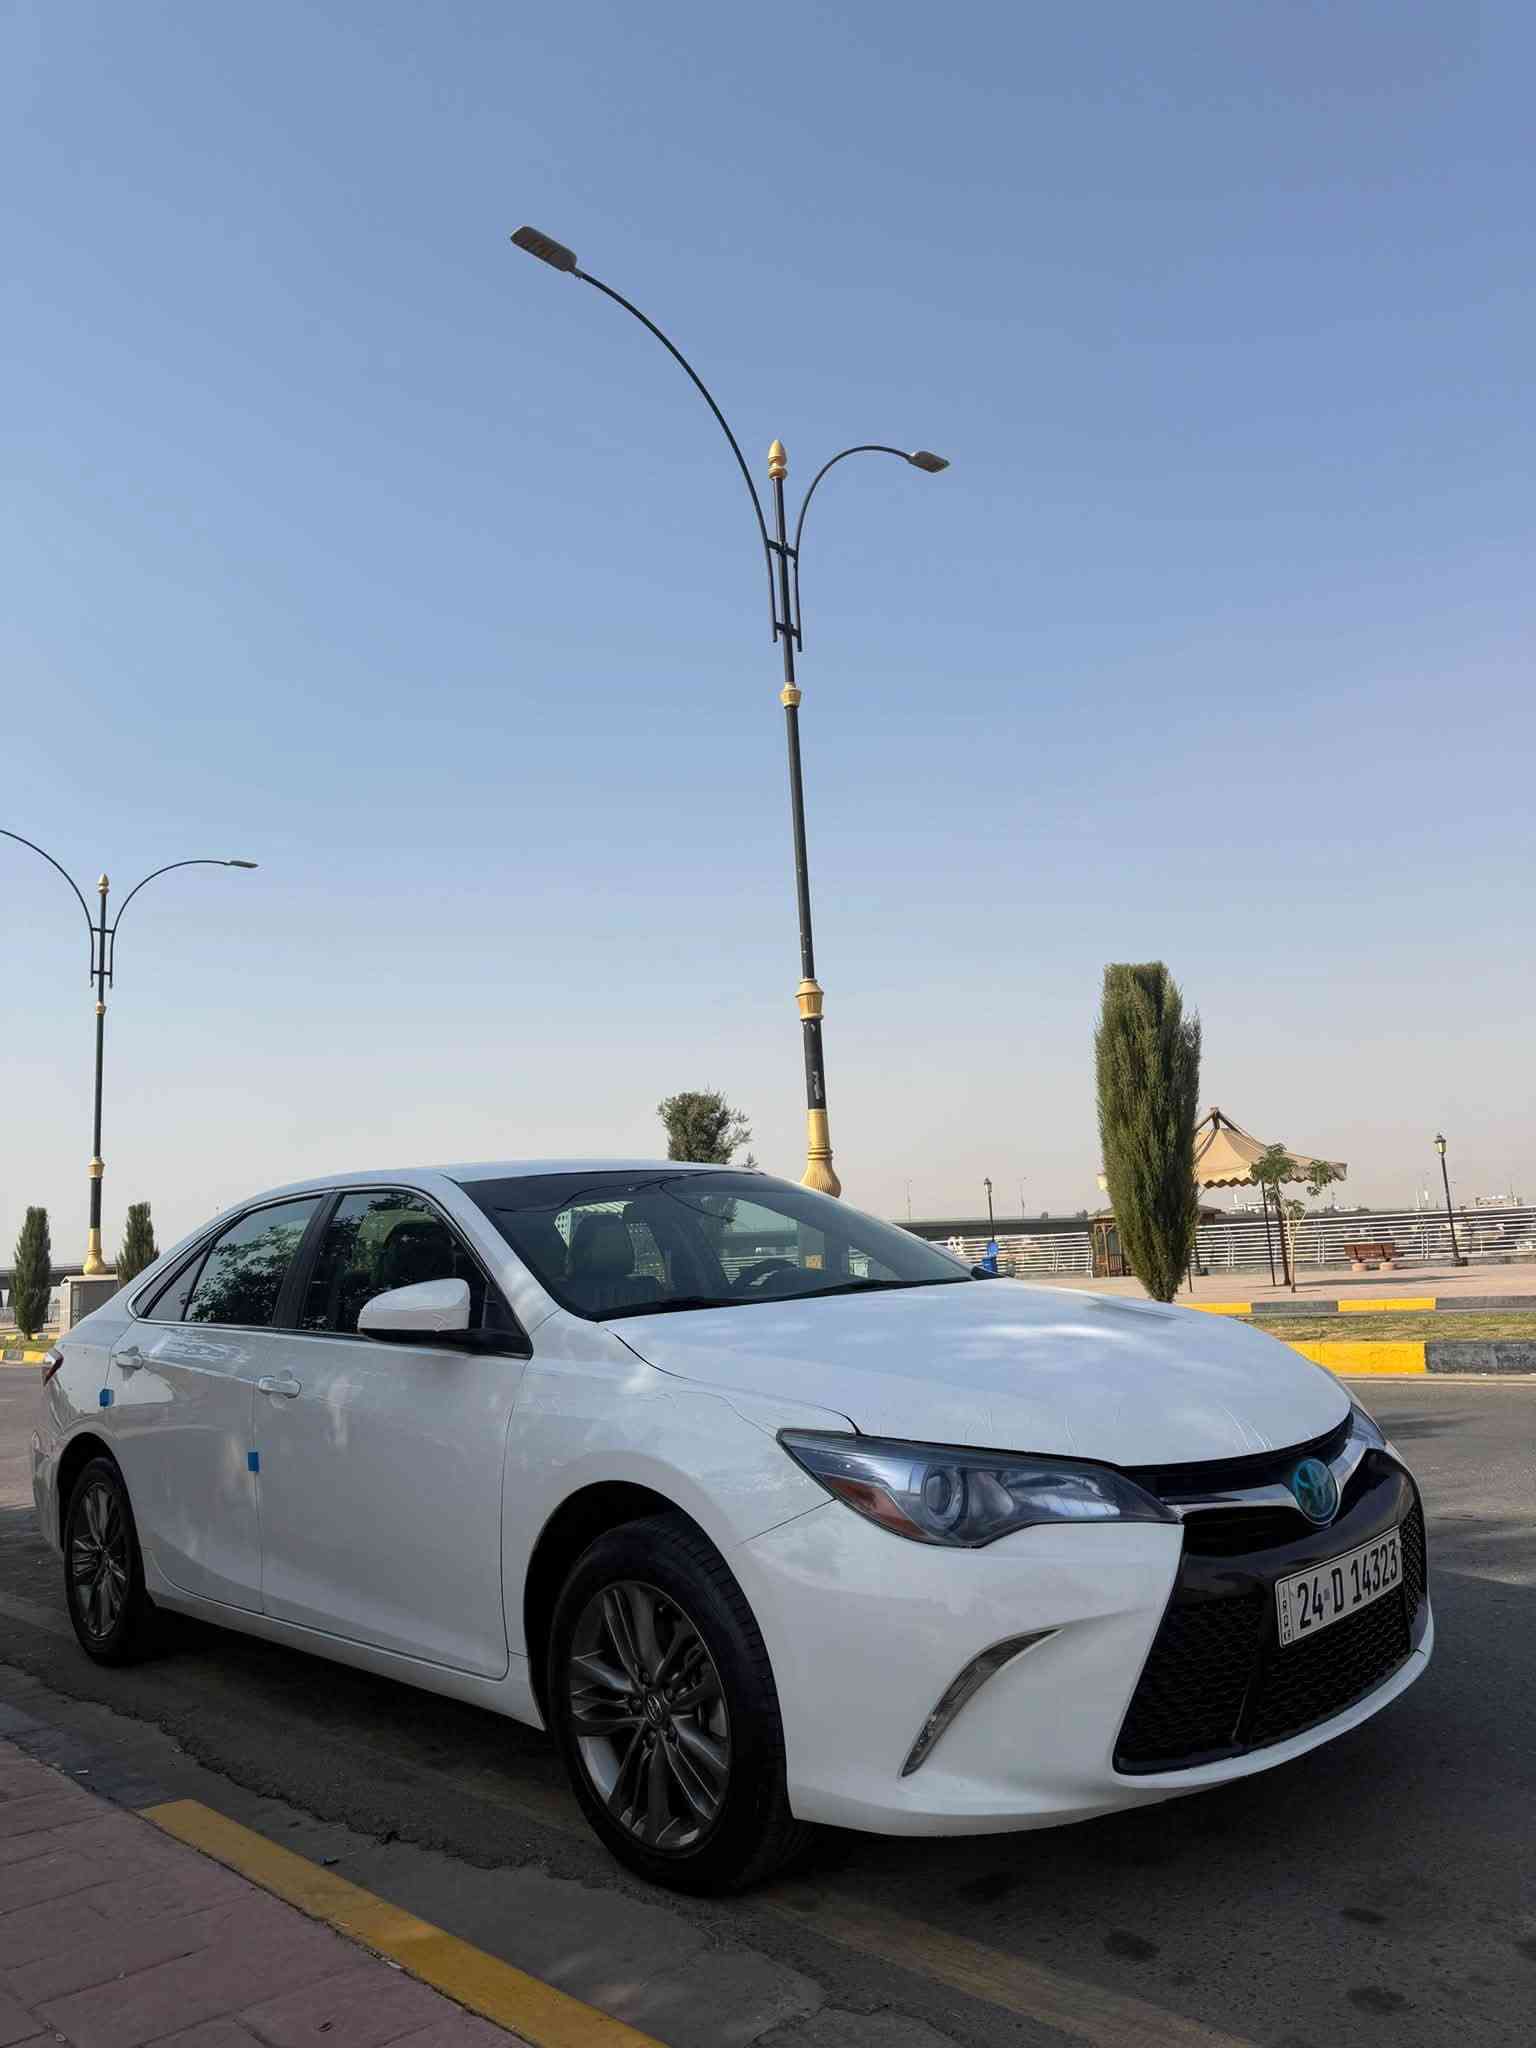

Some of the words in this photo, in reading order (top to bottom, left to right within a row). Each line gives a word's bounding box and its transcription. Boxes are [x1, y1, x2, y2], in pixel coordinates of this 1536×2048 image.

[1297, 1576, 1324, 1630] 24
[1331, 1567, 1344, 1614] D
[1350, 1538, 1398, 1604] 14323
